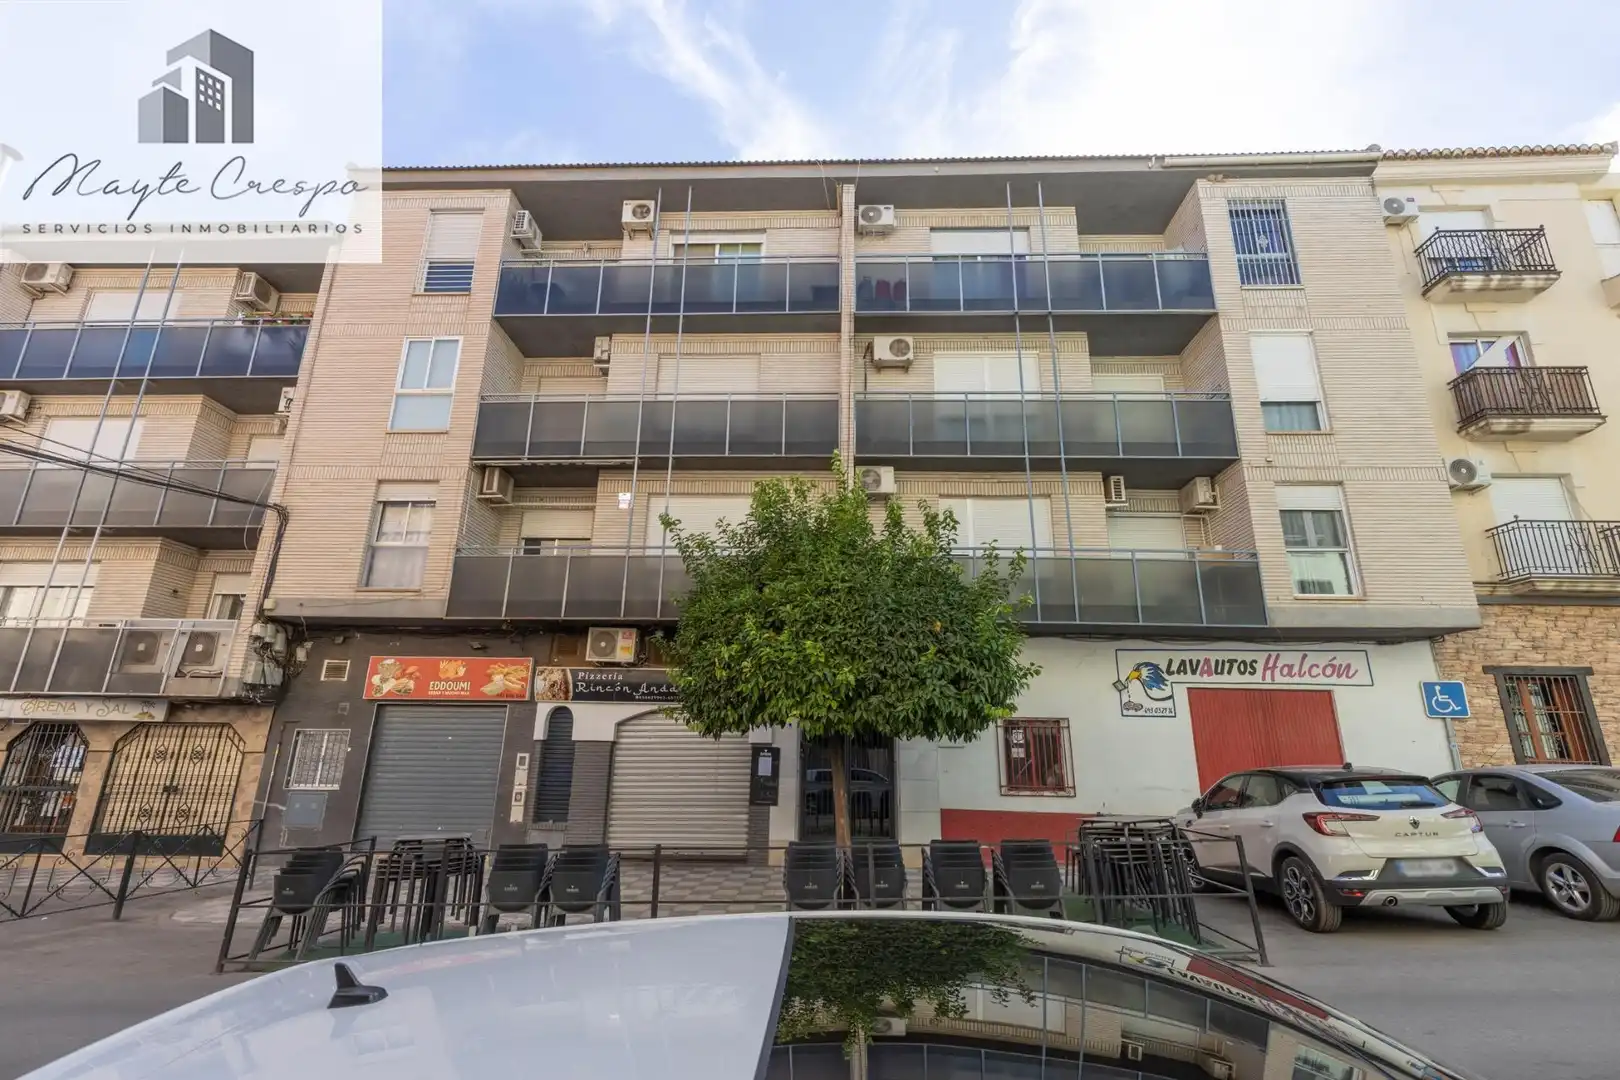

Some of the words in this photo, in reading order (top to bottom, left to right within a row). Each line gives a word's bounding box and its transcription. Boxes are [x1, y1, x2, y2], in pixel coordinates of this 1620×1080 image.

[1165, 656, 1258, 677] LAVAUTOS
[1261, 652, 1359, 682] Halcón
[575, 681, 632, 694] Rincón
[84, 701, 94, 713] Y
